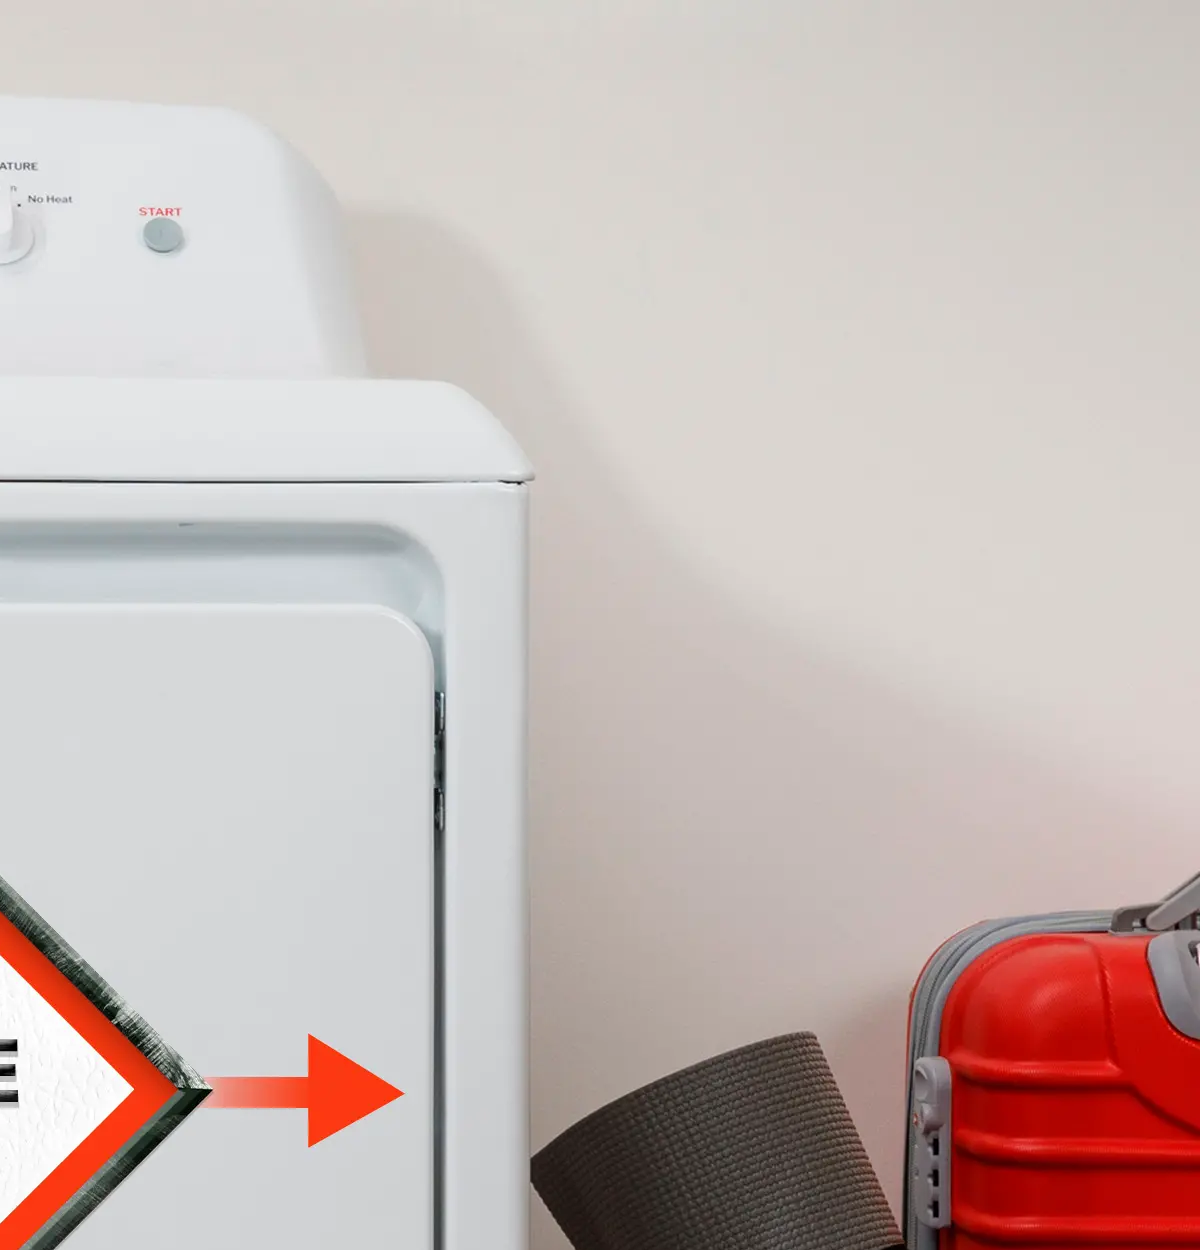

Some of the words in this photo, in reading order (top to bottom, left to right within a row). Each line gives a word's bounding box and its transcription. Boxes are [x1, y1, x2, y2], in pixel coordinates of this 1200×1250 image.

[27, 195, 44, 204] No
[46, 195, 73, 204] Heat
[138, 207, 182, 217] START
